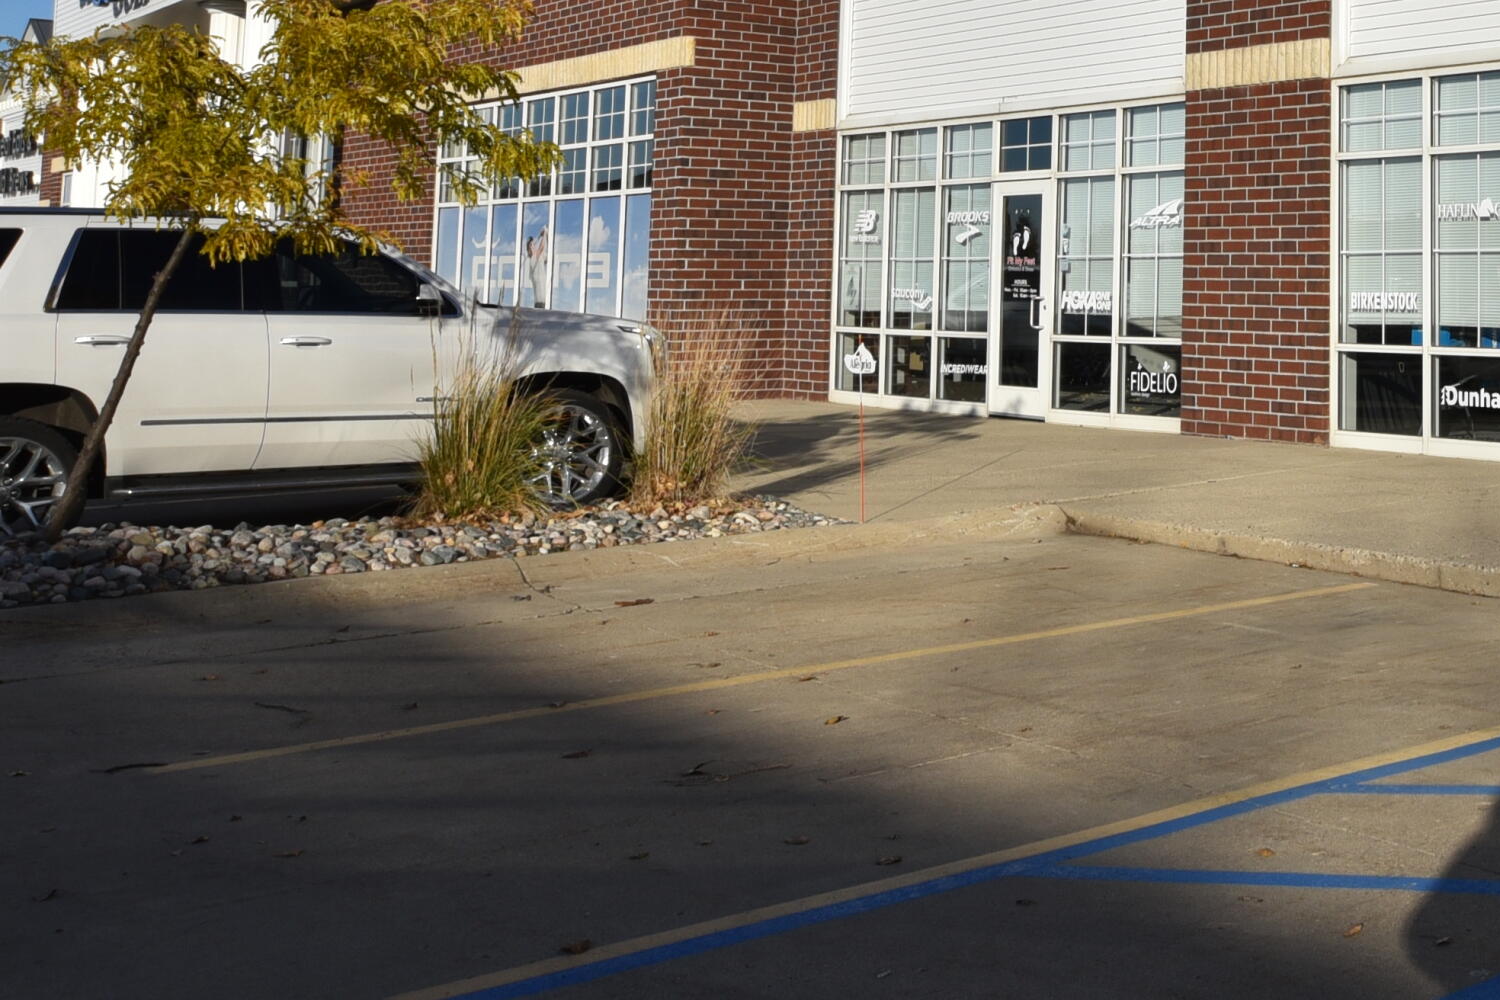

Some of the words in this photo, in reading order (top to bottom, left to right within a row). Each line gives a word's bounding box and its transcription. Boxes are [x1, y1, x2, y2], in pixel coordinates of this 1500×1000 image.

[947, 210, 989, 224] BROOKS
[1129, 214, 1181, 227] ALTRA
[1061, 290, 1098, 310] HOKA
[1351, 291, 1418, 310] BIRKENSTOCK
[941, 363, 988, 375] INCREDIWEAR
[1130, 371, 1178, 394] FIDELIO
